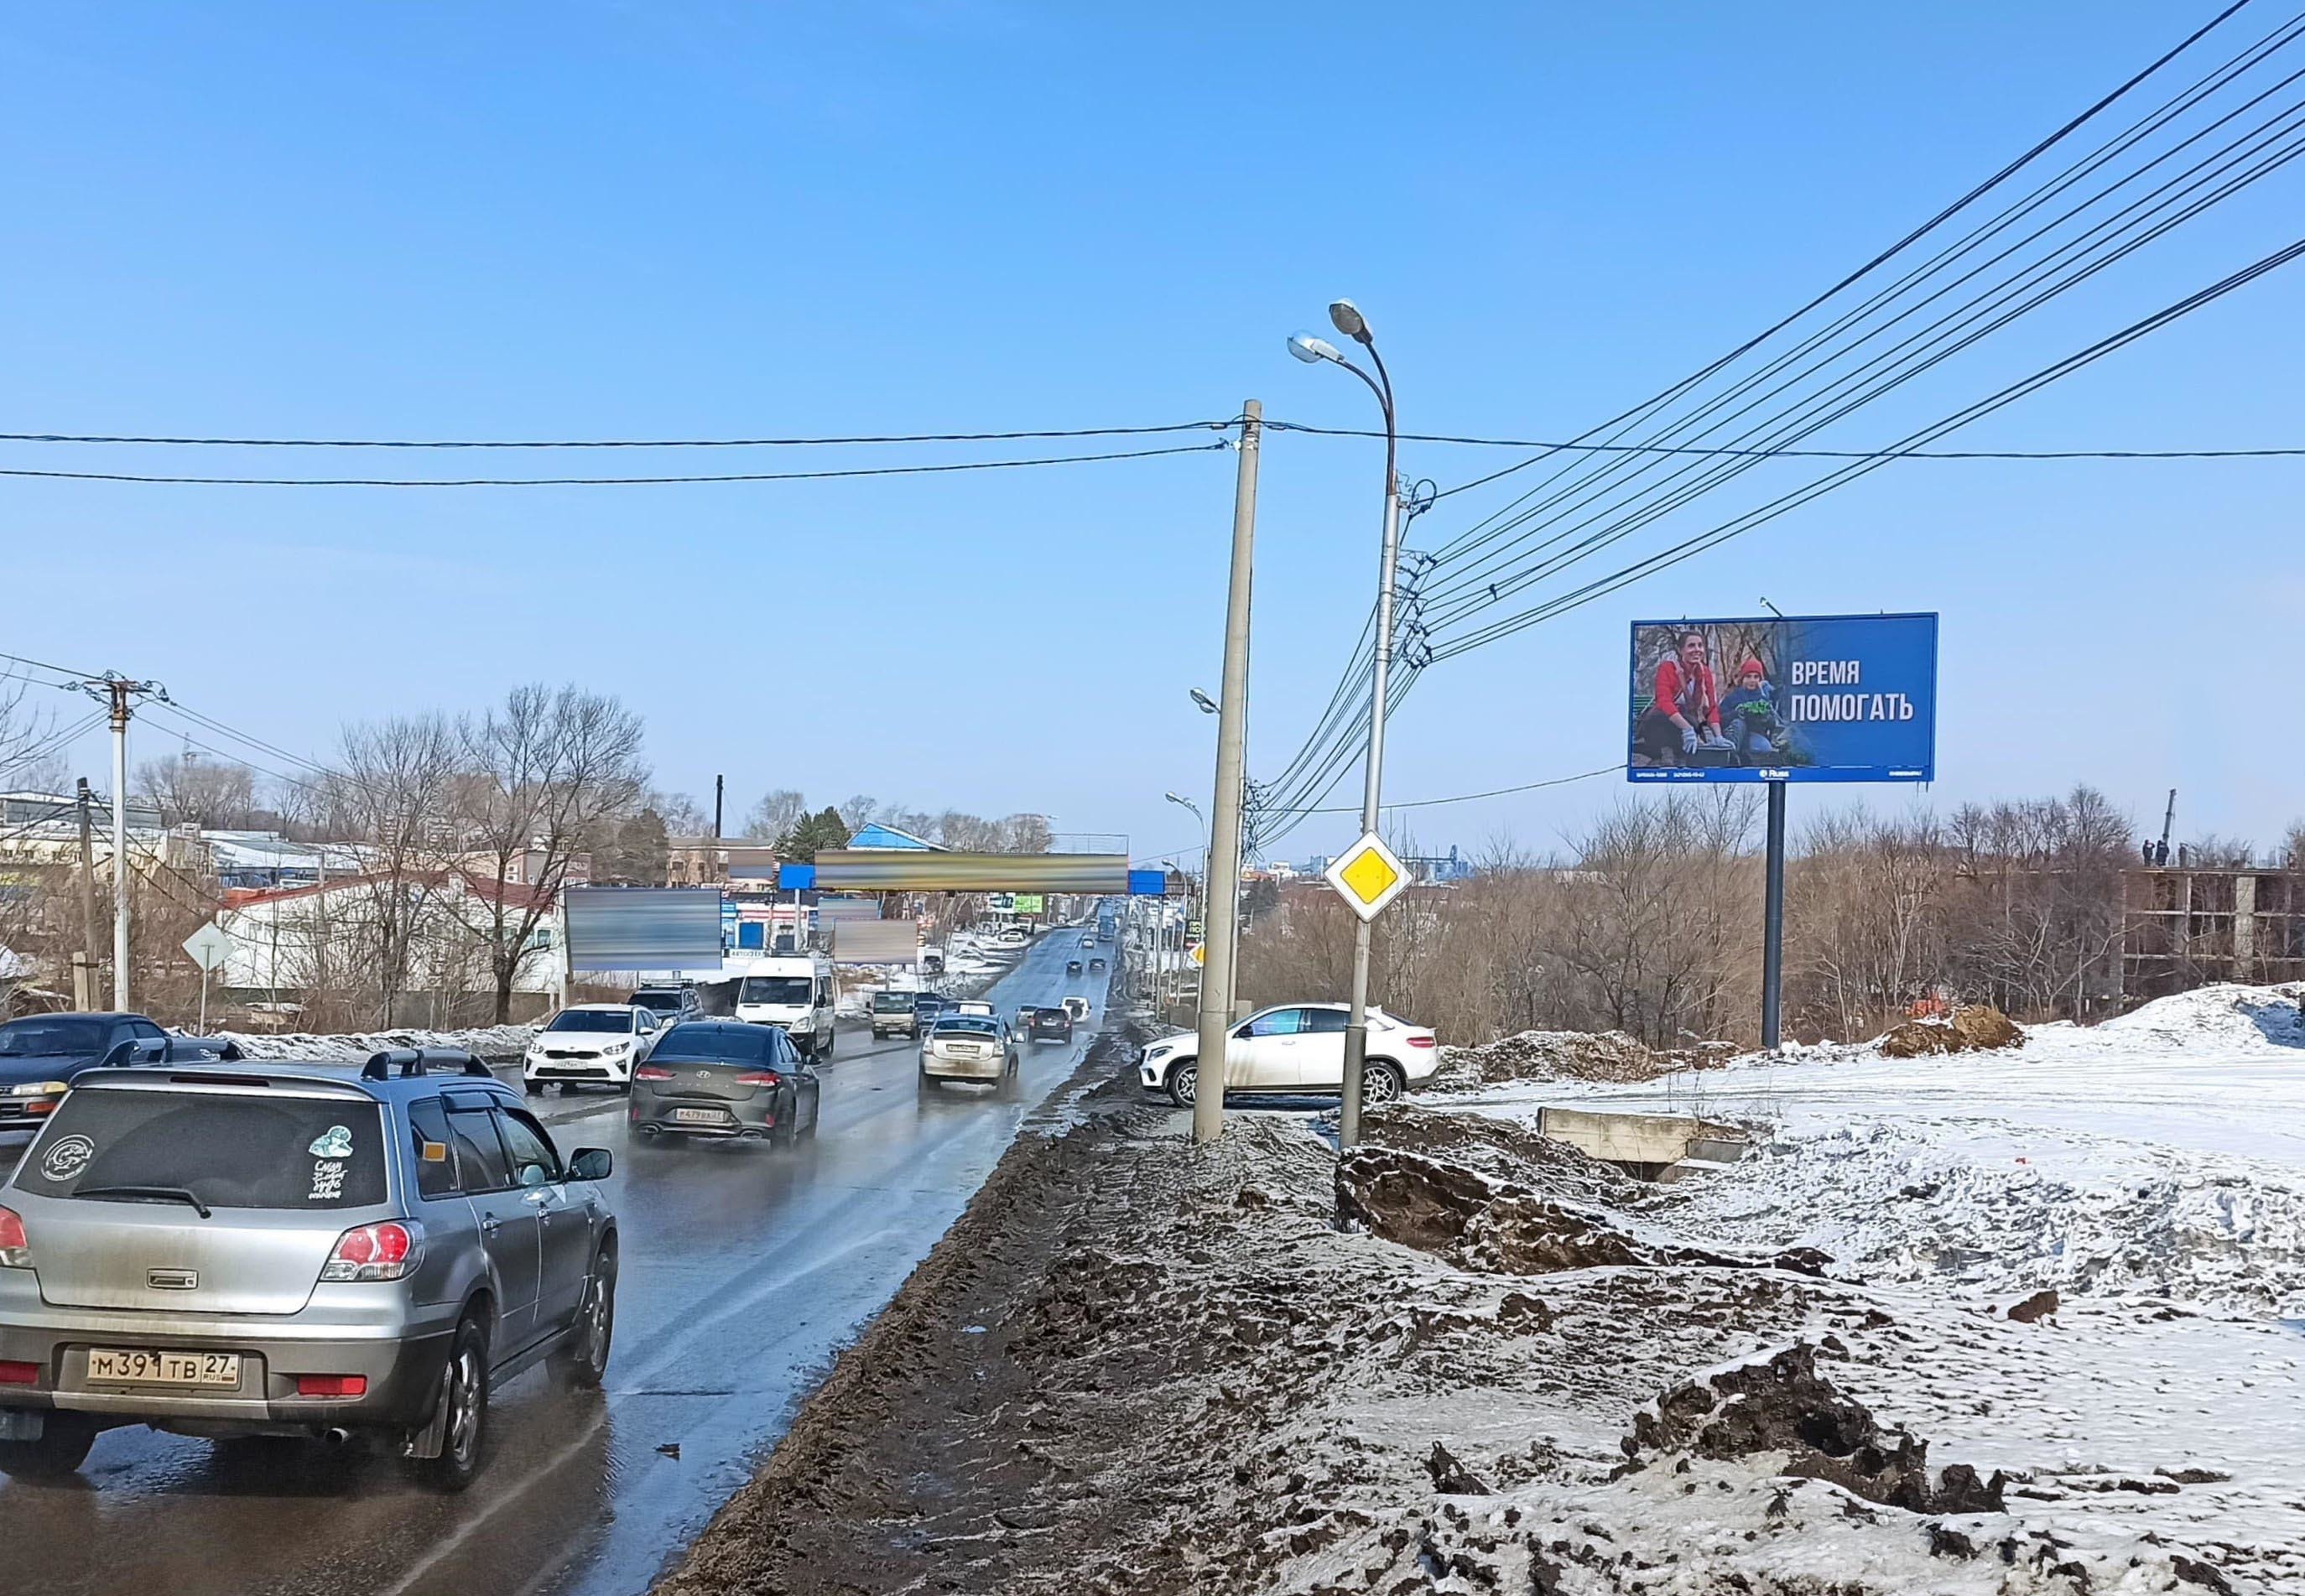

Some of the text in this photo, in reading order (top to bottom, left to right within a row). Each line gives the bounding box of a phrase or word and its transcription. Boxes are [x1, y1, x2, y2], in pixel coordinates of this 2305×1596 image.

[1792, 660, 1860, 685] ВРЕМЯ
[1791, 693, 1914, 721] ПОМОГАТЬ
[205, 1355, 229, 1374] 27
